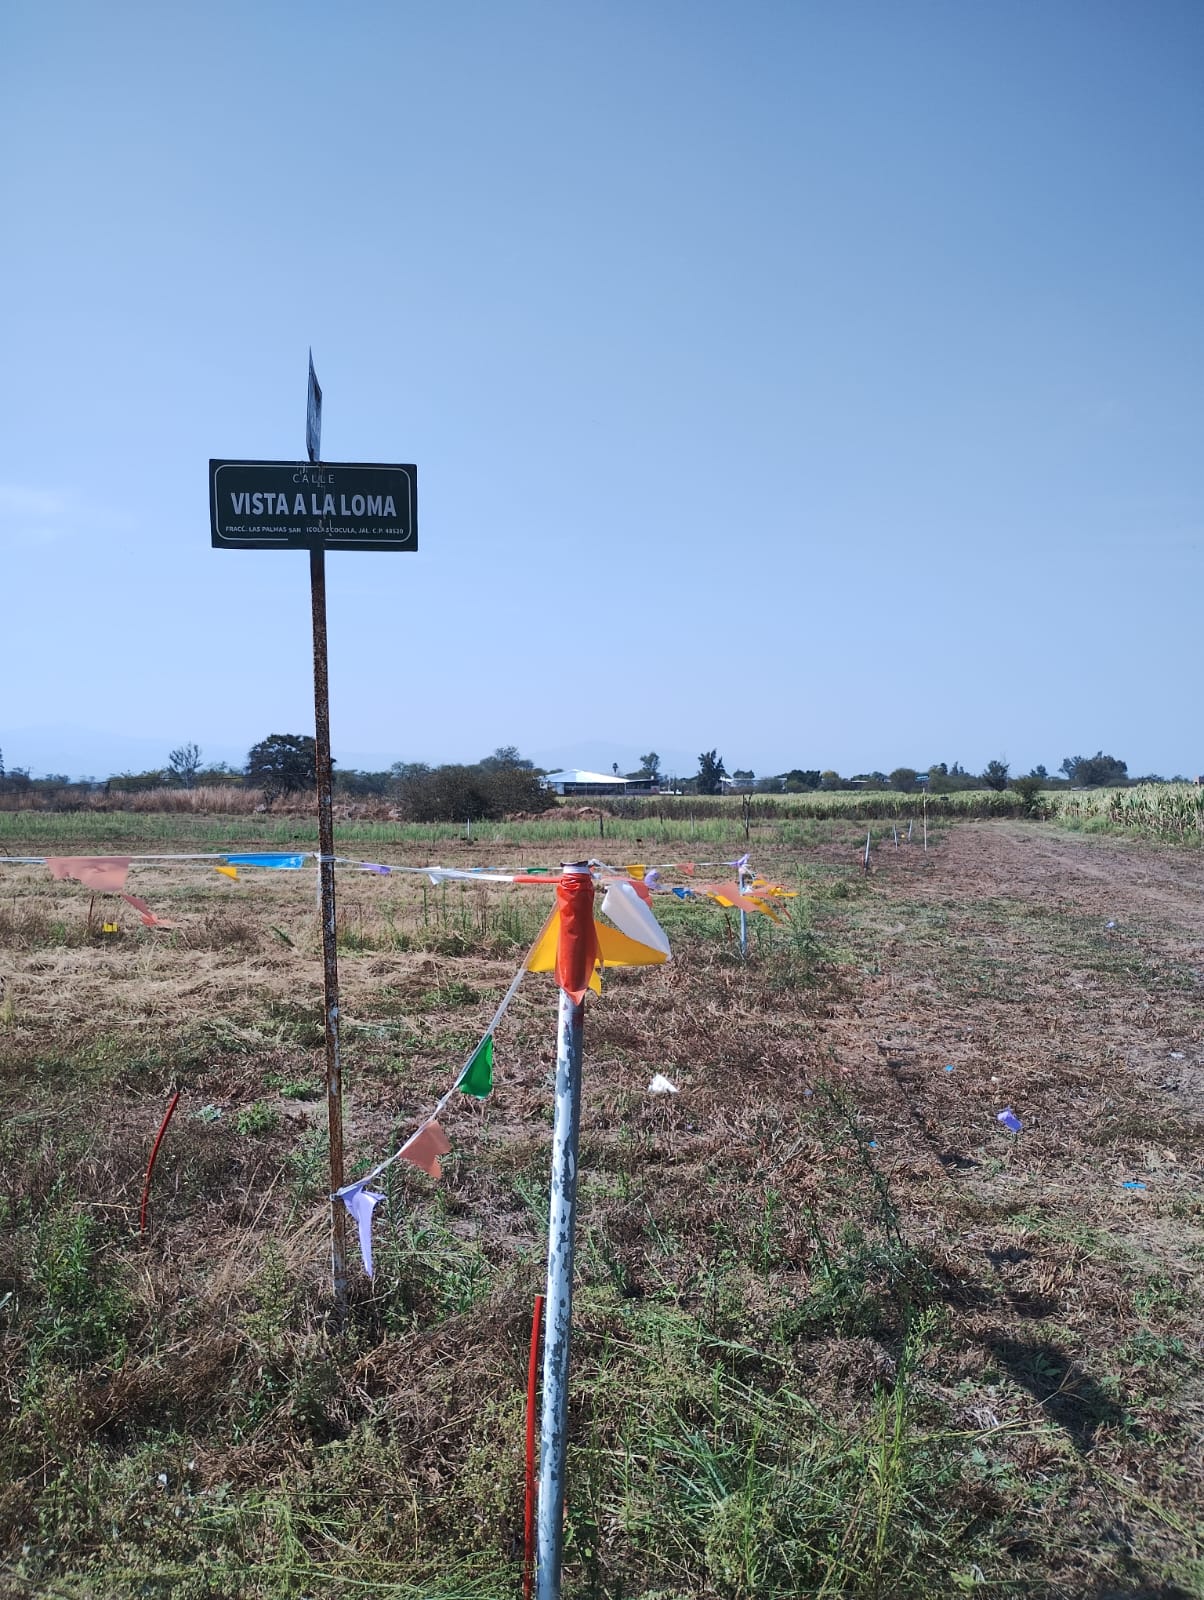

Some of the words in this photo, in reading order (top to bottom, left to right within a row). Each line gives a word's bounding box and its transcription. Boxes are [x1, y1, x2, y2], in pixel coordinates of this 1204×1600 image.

[292, 473, 335, 484] CALLE
[230, 492, 289, 516] VISTA
[293, 493, 307, 516] A
[311, 493, 335, 516] LA
[340, 494, 397, 517] LOMA
